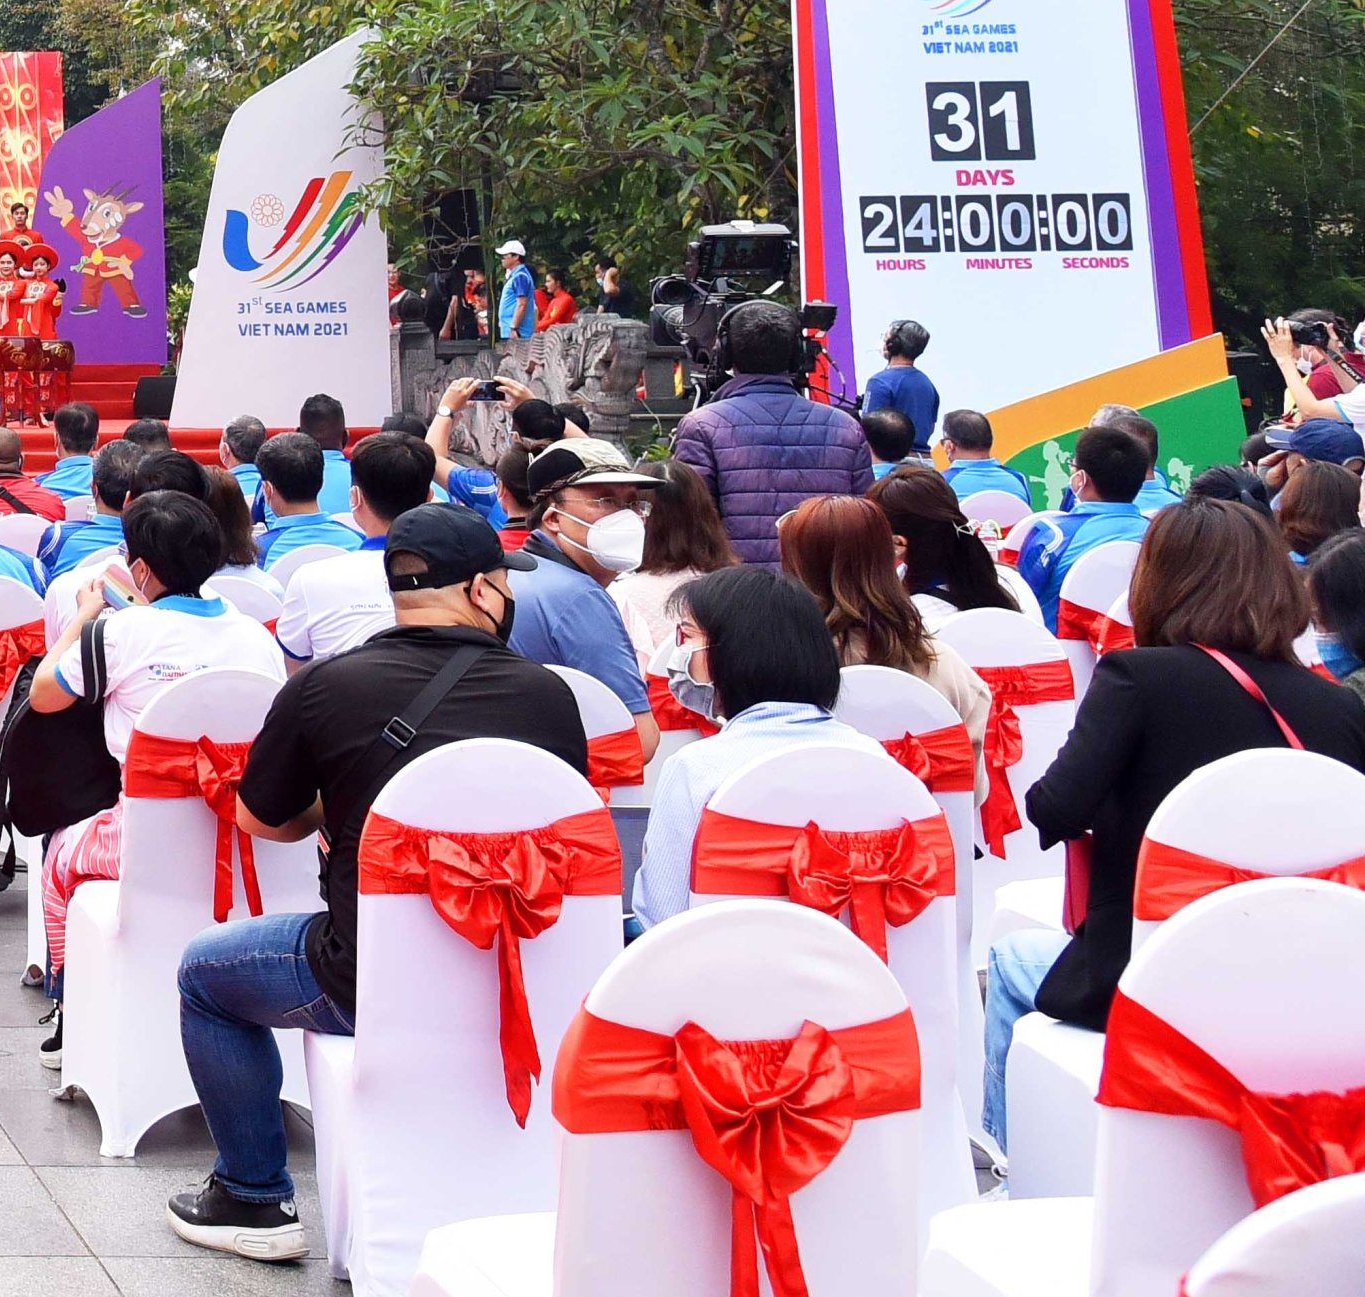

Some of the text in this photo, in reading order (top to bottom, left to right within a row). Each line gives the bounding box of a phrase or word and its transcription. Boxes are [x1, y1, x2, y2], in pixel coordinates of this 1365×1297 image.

[945, 24, 970, 35] SEA
[972, 24, 1017, 35] GAMES
[923, 40, 1019, 54] VIET NAM 2021
[933, 90, 1021, 152] 31
[956, 169, 1015, 187] DAYS
[876, 257, 1130, 271] HOURS MINUTES SECONDS
[265, 302, 293, 314] SEA
[296, 301, 347, 314] GAMES
[238, 323, 348, 336] VIET NAM 2021
[1340, 362, 1362, 381] SONY
